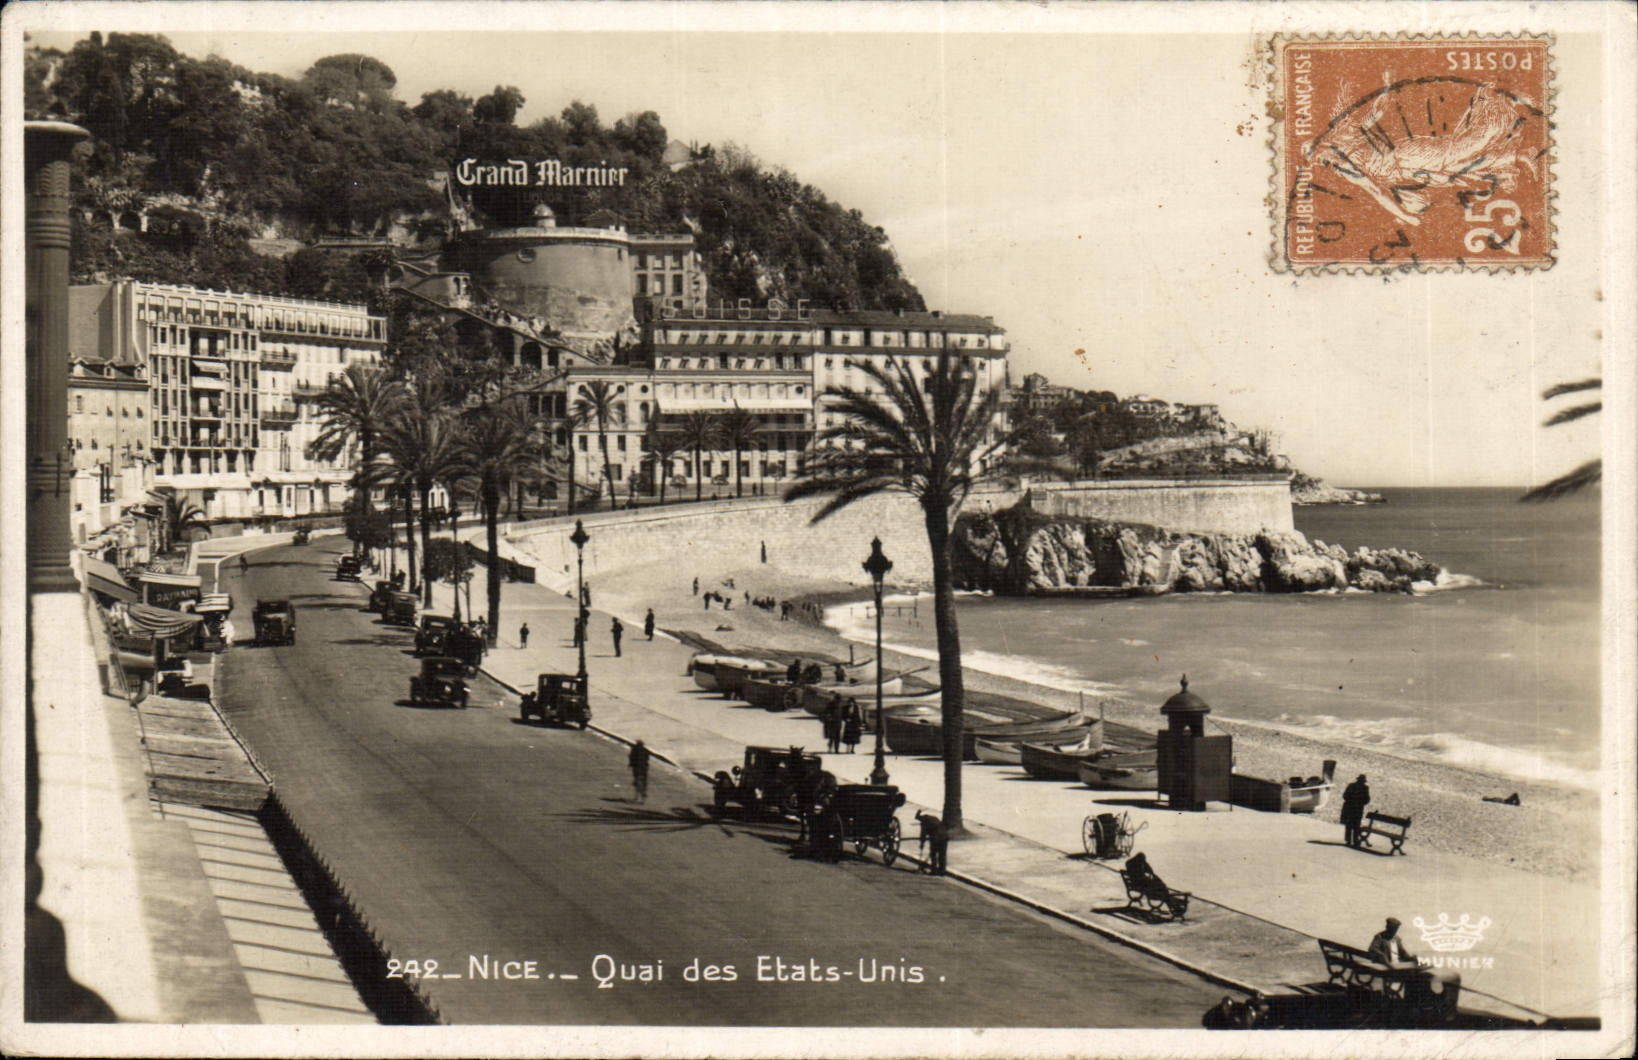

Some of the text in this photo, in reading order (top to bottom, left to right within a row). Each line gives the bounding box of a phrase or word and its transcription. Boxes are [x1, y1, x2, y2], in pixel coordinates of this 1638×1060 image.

[1446, 51, 1532, 70] POSTES
[1295, 52, 1314, 136] FRANÇAISE
[456, 158, 630, 187] Grand Marnier
[662, 297, 811, 320] SUISSE
